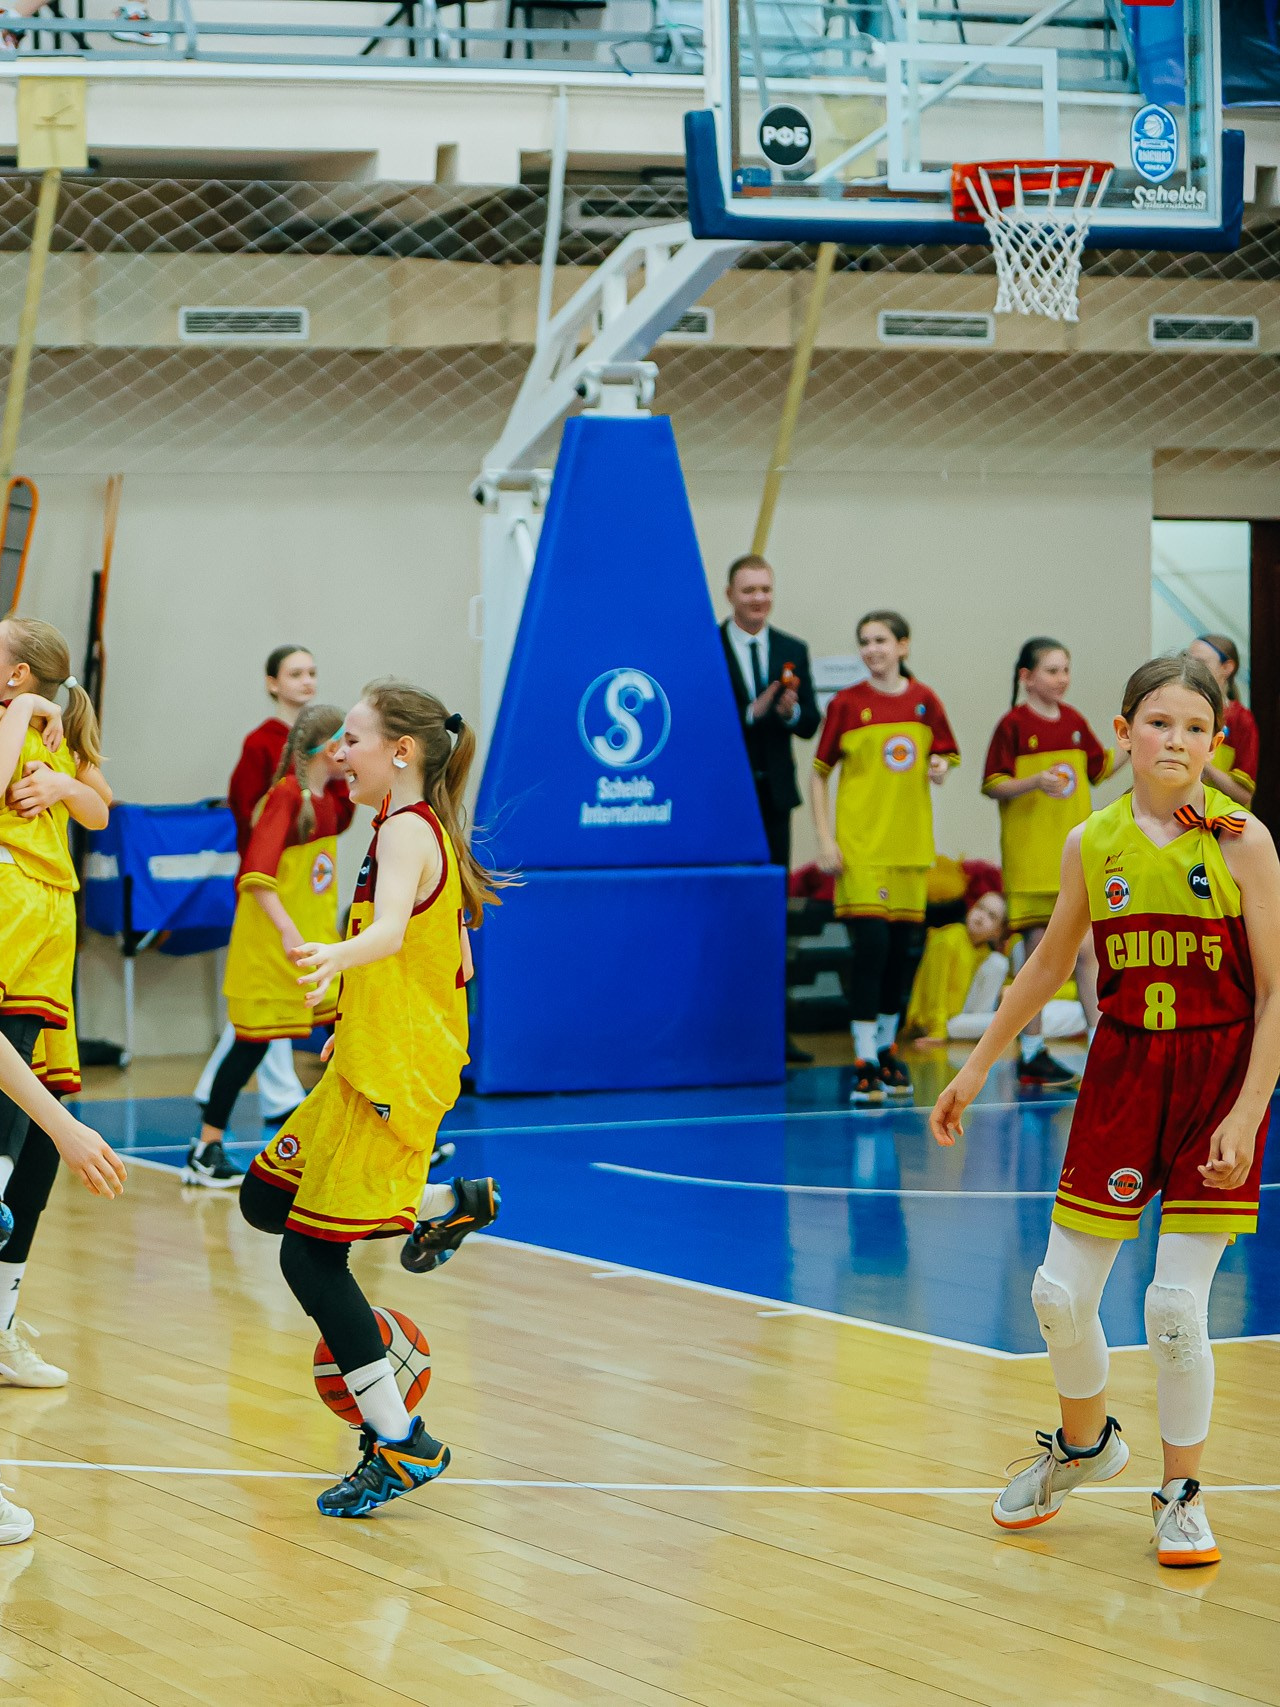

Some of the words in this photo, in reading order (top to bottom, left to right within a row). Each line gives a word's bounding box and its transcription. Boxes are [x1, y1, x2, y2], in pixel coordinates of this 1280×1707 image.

[763, 125, 809, 147] РФБ
[1132, 185, 1207, 210] Schelde
[597, 775, 655, 800] Schelde
[1106, 930, 1197, 970] СШОР
[1202, 936, 1222, 971] 5
[1143, 982, 1176, 1030] 8
